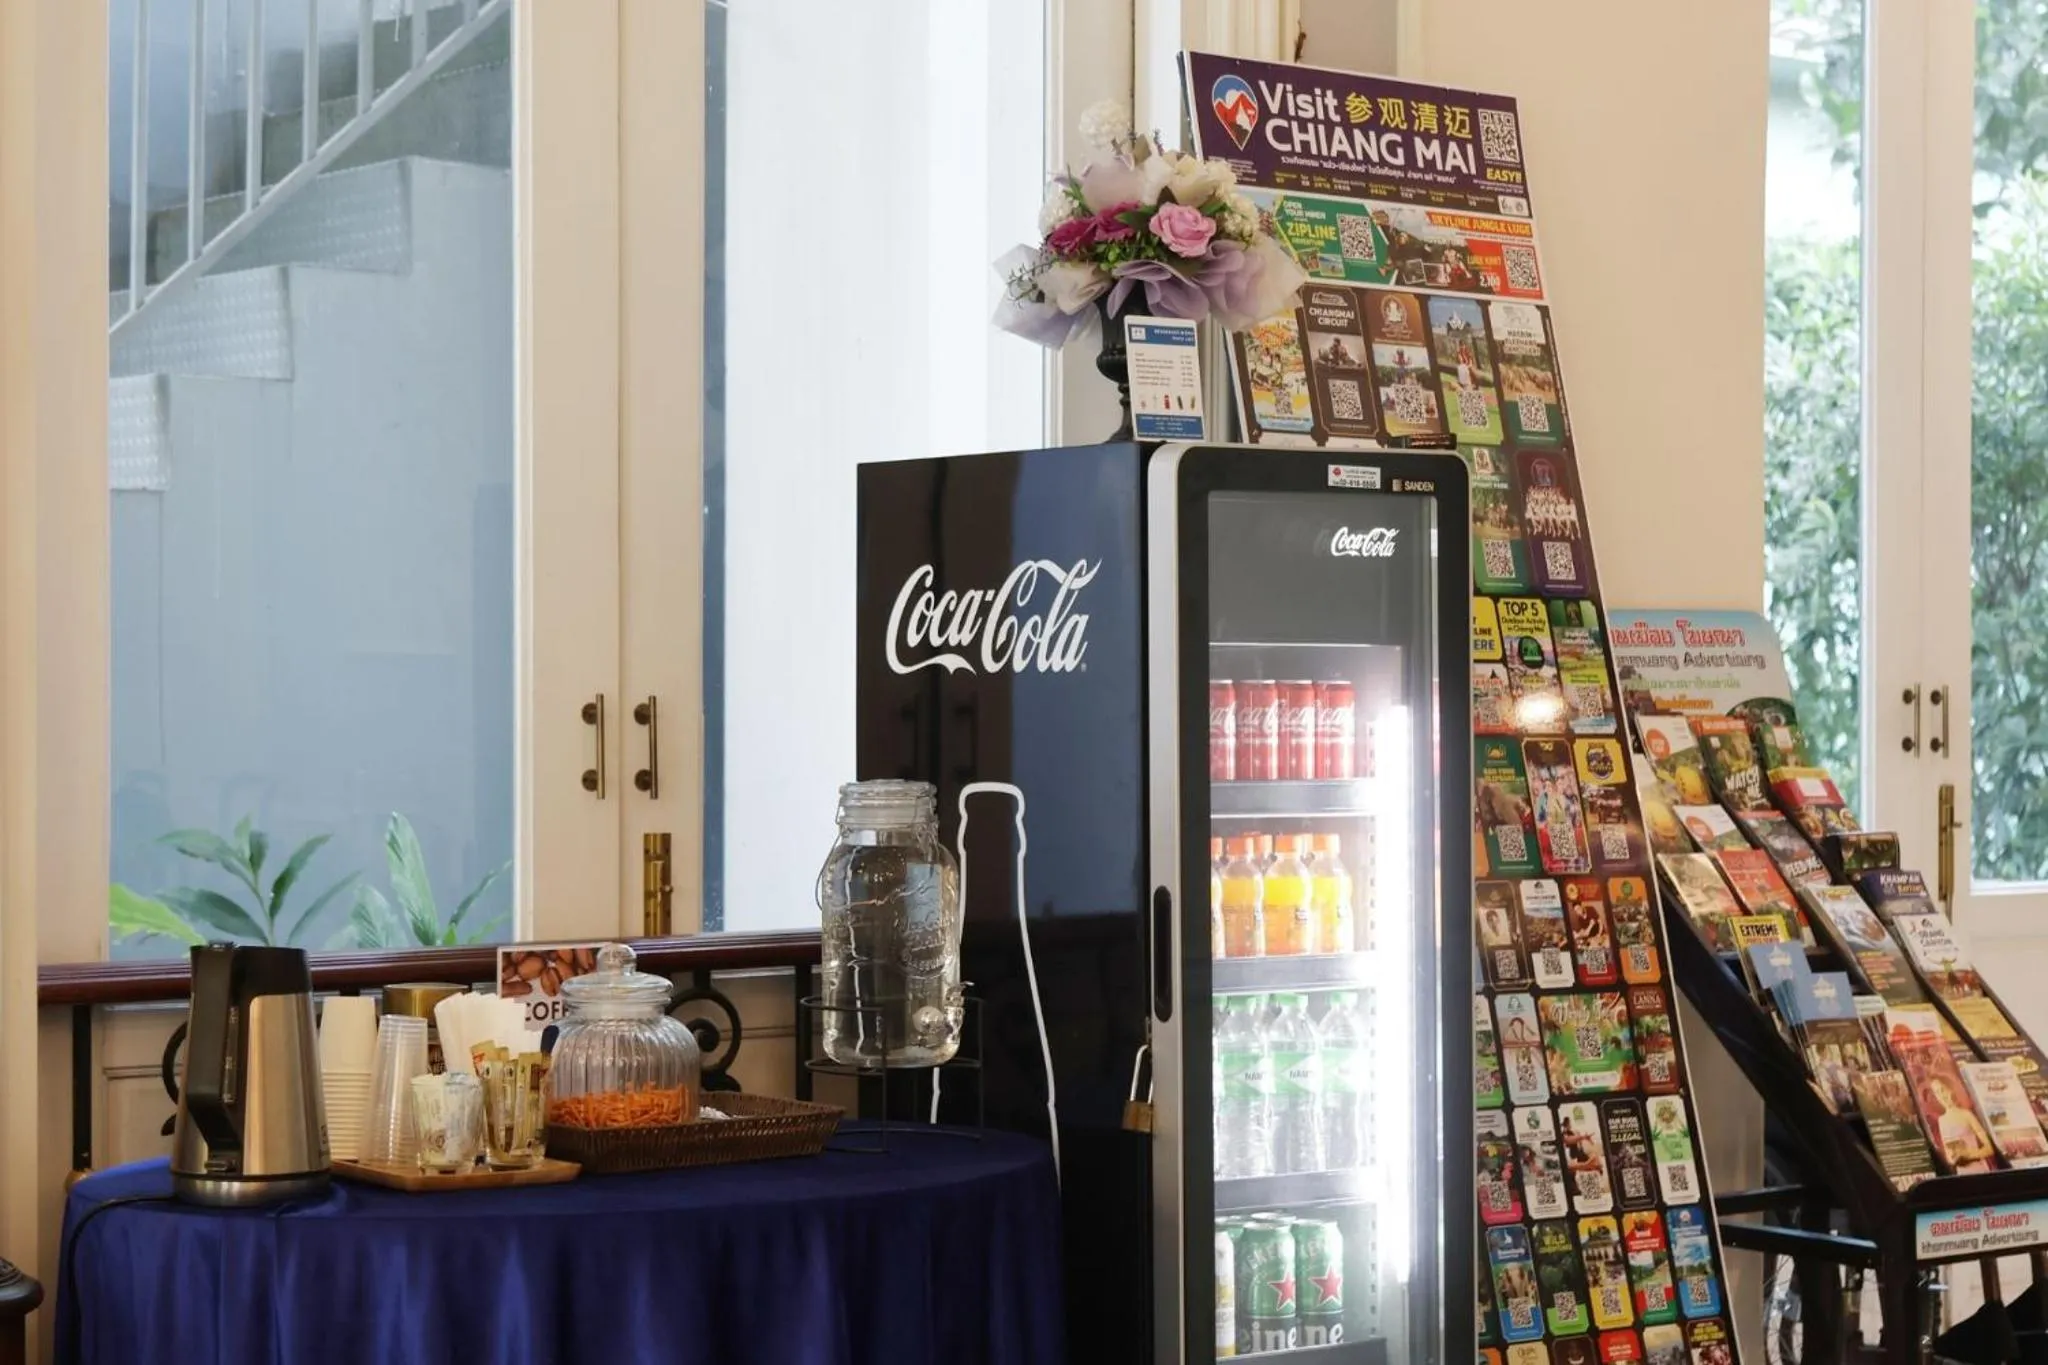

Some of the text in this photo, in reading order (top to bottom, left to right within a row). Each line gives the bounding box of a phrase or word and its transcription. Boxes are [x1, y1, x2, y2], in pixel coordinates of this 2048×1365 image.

[1258, 79, 1341, 122] Visit
[1345, 92, 1473, 139] 参观清迈
[1265, 118, 1477, 175] CHIANG MAI
[1286, 222, 1338, 241] ZIPLINE
[1318, 317, 1348, 328] CIRCUIT
[1404, 480, 1434, 492] SANDEN
[1330, 526, 1400, 557] Coca-Cola
[1503, 600, 1539, 616] TOP 5
[885, 557, 1103, 677] Coca-Cola
[1473, 627, 1492, 636] LINE
[1610, 621, 1675, 647] นเมือง
[1473, 640, 1495, 650] ERE
[1684, 651, 1766, 670] Advertising
[1739, 923, 1780, 938] EXTREME
[1610, 1132, 1643, 1143] ILLEGAL
[1982, 1230, 2038, 1246] Advertising
